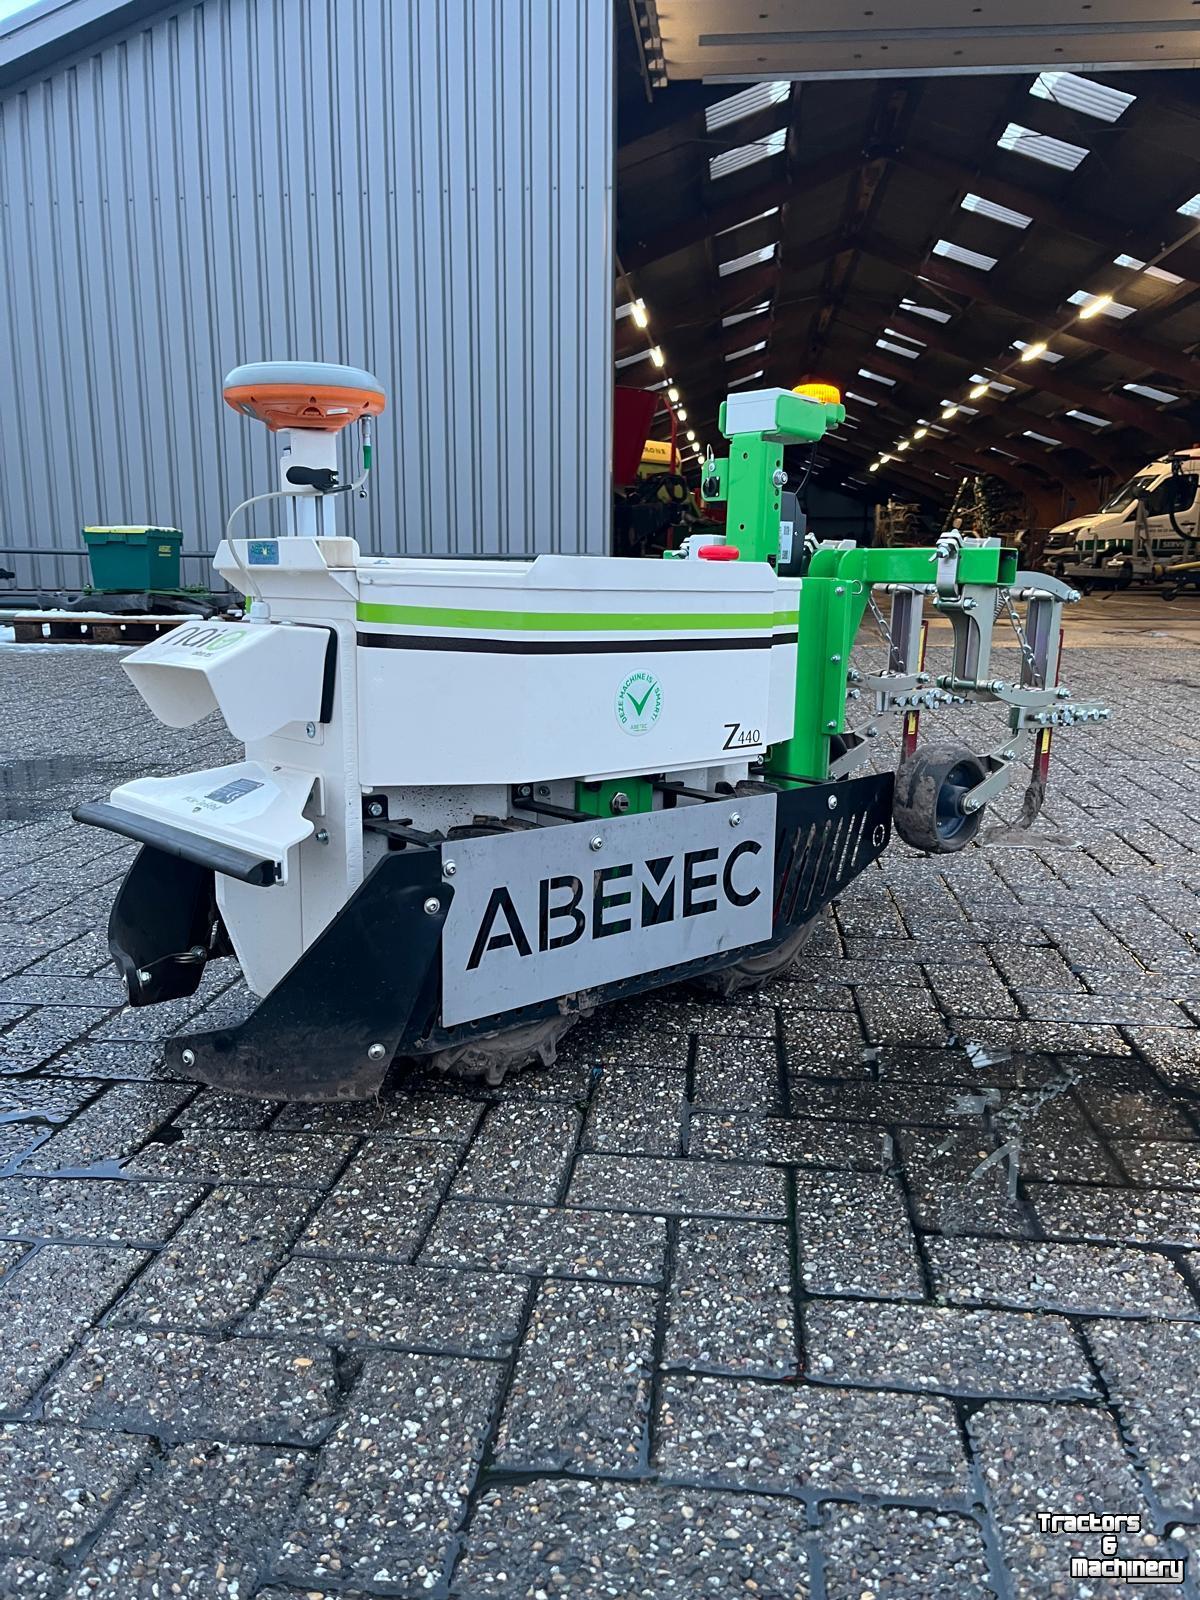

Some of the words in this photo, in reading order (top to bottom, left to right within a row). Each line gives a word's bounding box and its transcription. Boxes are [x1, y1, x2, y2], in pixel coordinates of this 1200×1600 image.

[619, 672, 646, 699] MACHINE
[646, 674, 653, 683] IS
[618, 700, 627, 724] DEZE
[722, 722, 762, 750] Z440
[465, 840, 762, 971] ABEMEC
